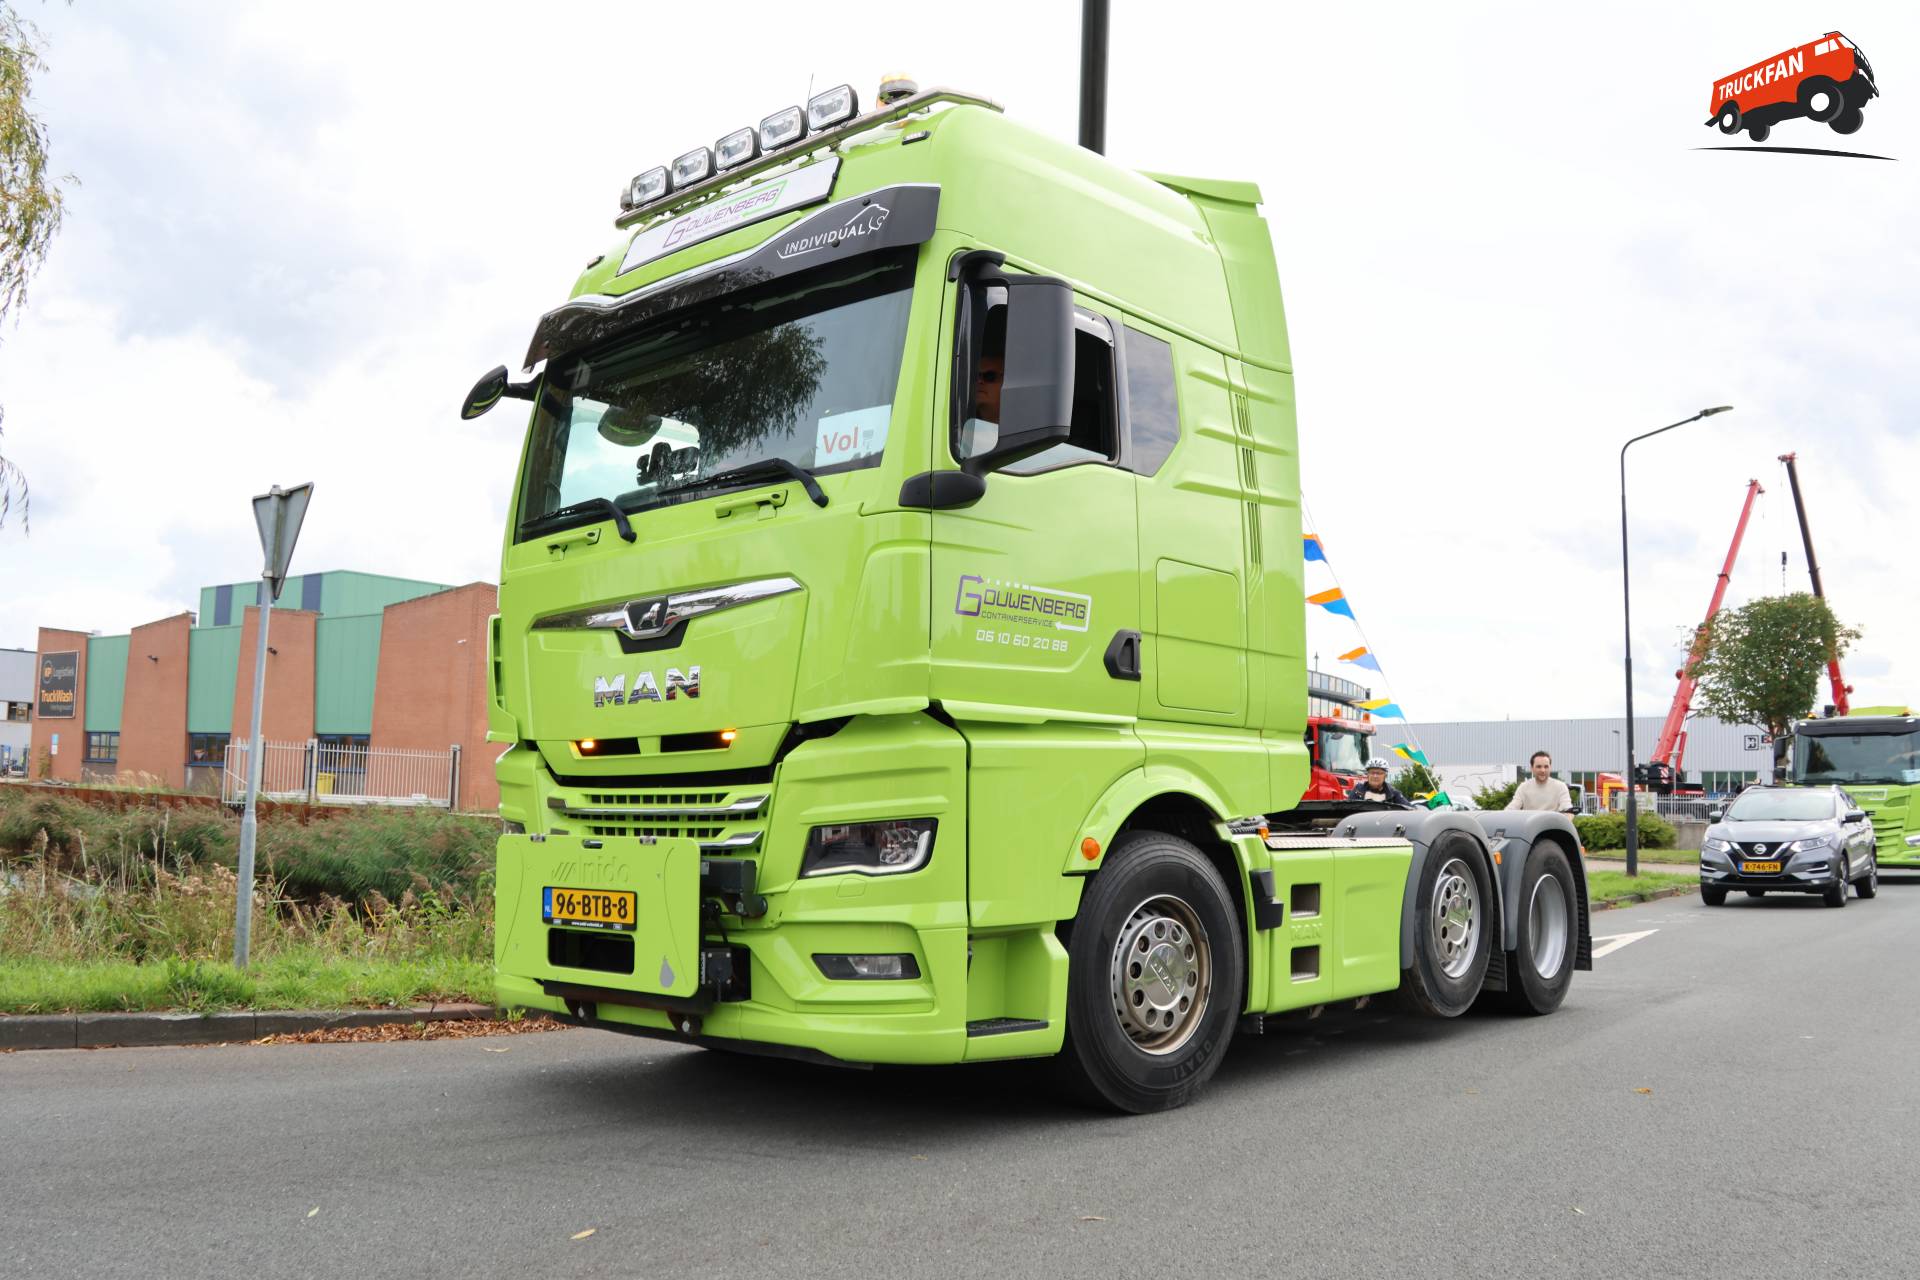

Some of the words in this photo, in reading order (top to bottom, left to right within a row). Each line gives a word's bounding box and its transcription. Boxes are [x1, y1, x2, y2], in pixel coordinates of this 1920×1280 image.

[663, 187, 779, 249] GOUWENBERG
[784, 224, 866, 255] INDIVIDUAL
[822, 426, 859, 455] Vol
[955, 574, 1087, 620] GOUWENBERG
[981, 610, 1053, 628] CONTAINERSERVICE
[976, 629, 994, 642] 06
[998, 632, 1010, 645] 10
[1013, 634, 1030, 648] 60
[1033, 636, 1050, 650] 20
[41, 689, 73, 702] TruckWash
[594, 665, 701, 708] MAN
[556, 892, 628, 919] 96-BTB-8
